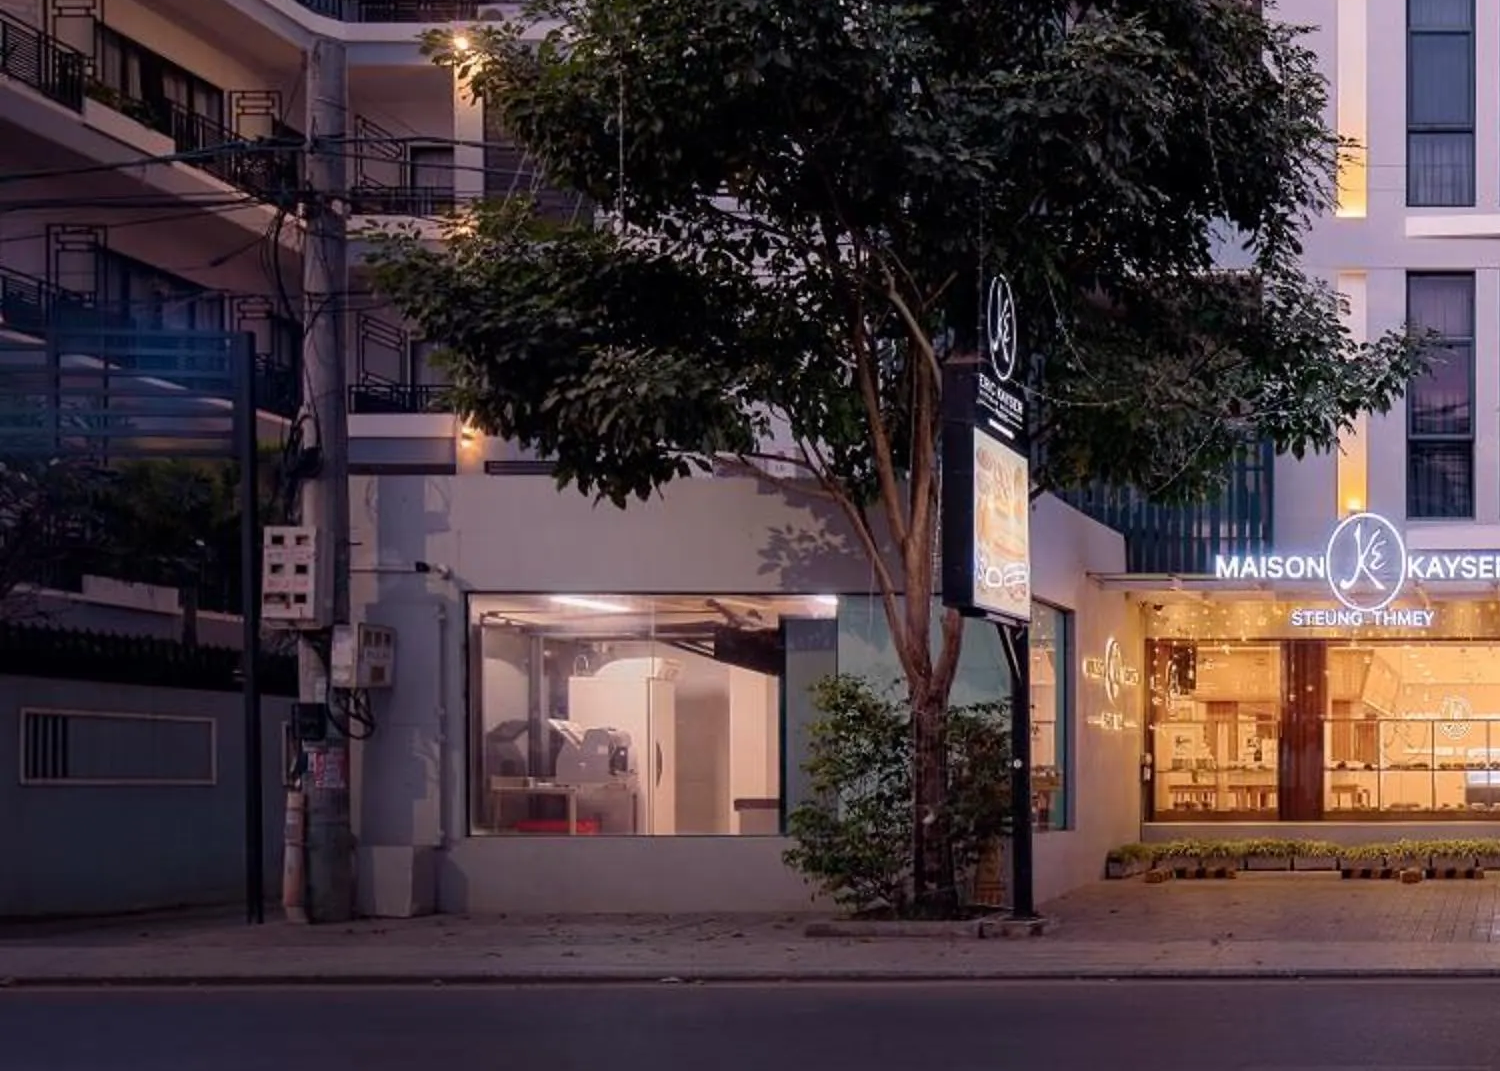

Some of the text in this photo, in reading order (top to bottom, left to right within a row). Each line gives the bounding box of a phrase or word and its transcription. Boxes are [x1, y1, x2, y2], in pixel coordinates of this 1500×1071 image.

[1214, 555, 1325, 579] MAISON
[1291, 609, 1435, 627] STEUNG THMEY
